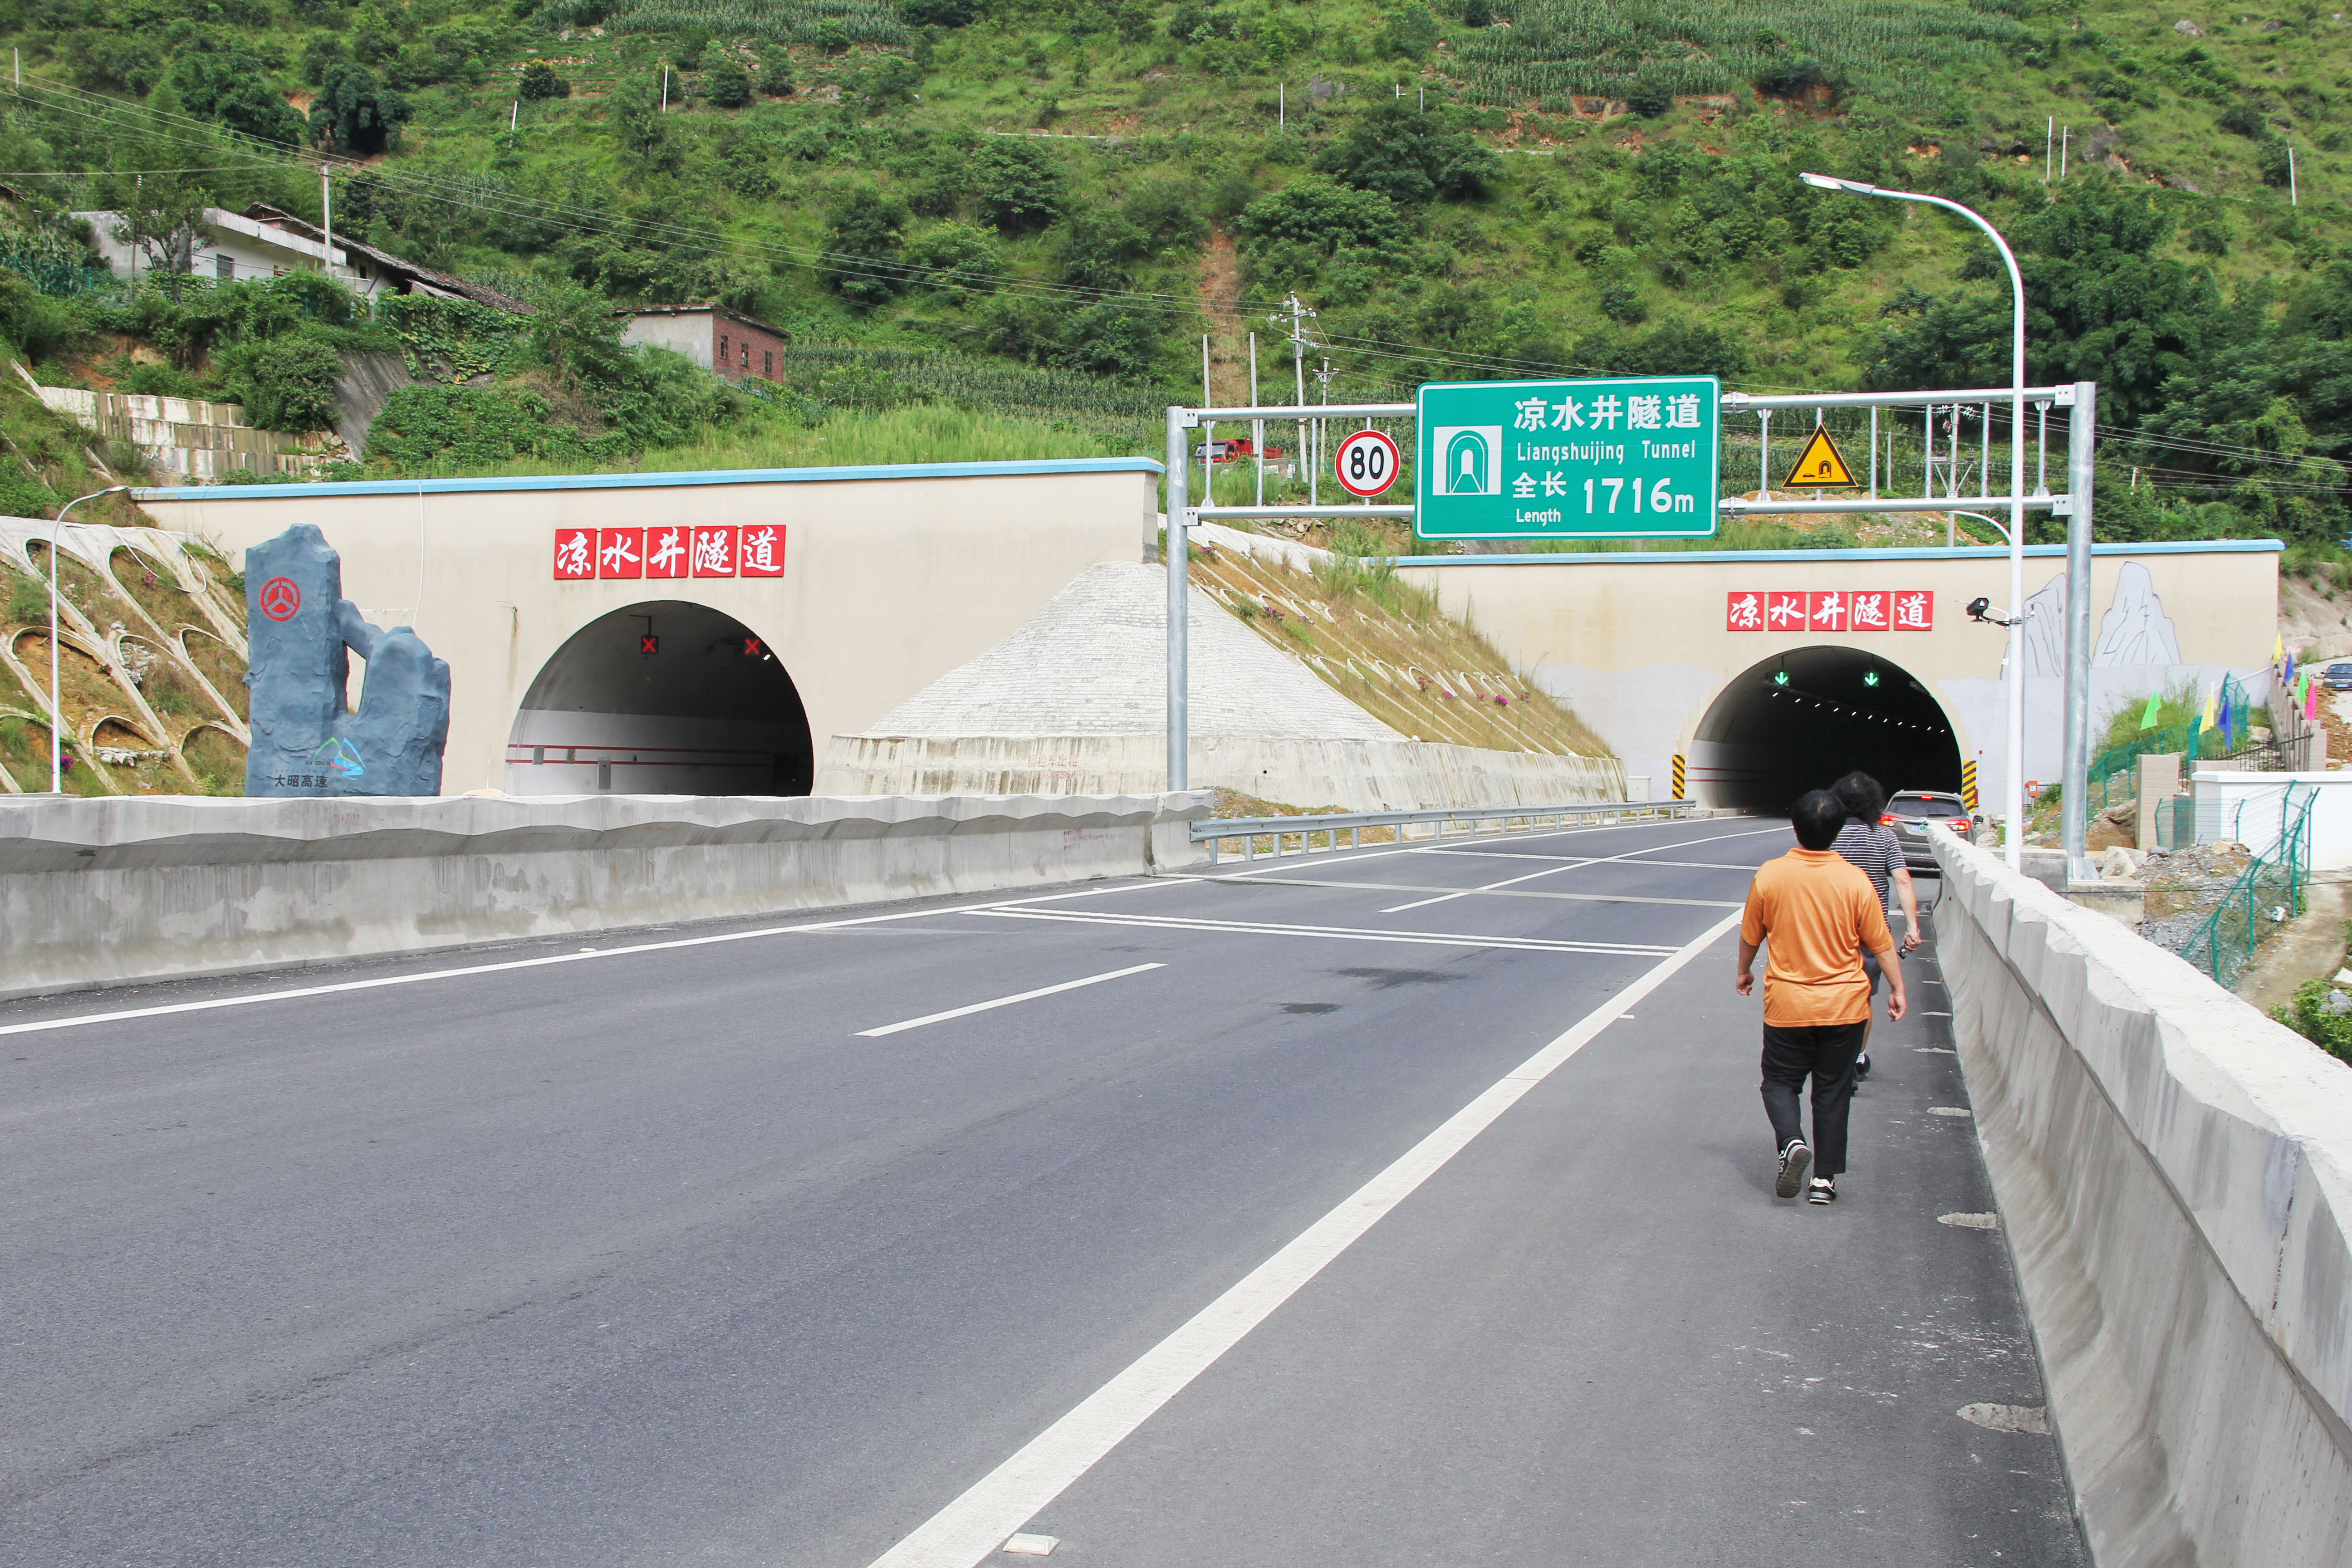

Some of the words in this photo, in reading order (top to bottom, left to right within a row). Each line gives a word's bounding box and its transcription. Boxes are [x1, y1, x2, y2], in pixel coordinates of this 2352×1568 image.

[1514, 394, 1701, 431] 凉水井隧道
[1351, 446, 1384, 480] 80
[1517, 441, 1624, 466] Liangshuijing
[1642, 440, 1696, 459] Tunnel
[1512, 471, 1567, 498] 全长
[1583, 477, 1694, 514] 1716m
[1516, 508, 1562, 527] Length
[557, 526, 781, 578] 凉水井隧道
[1730, 591, 1931, 631] 凉水井隧道
[274, 774, 328, 788] 大昭高速
